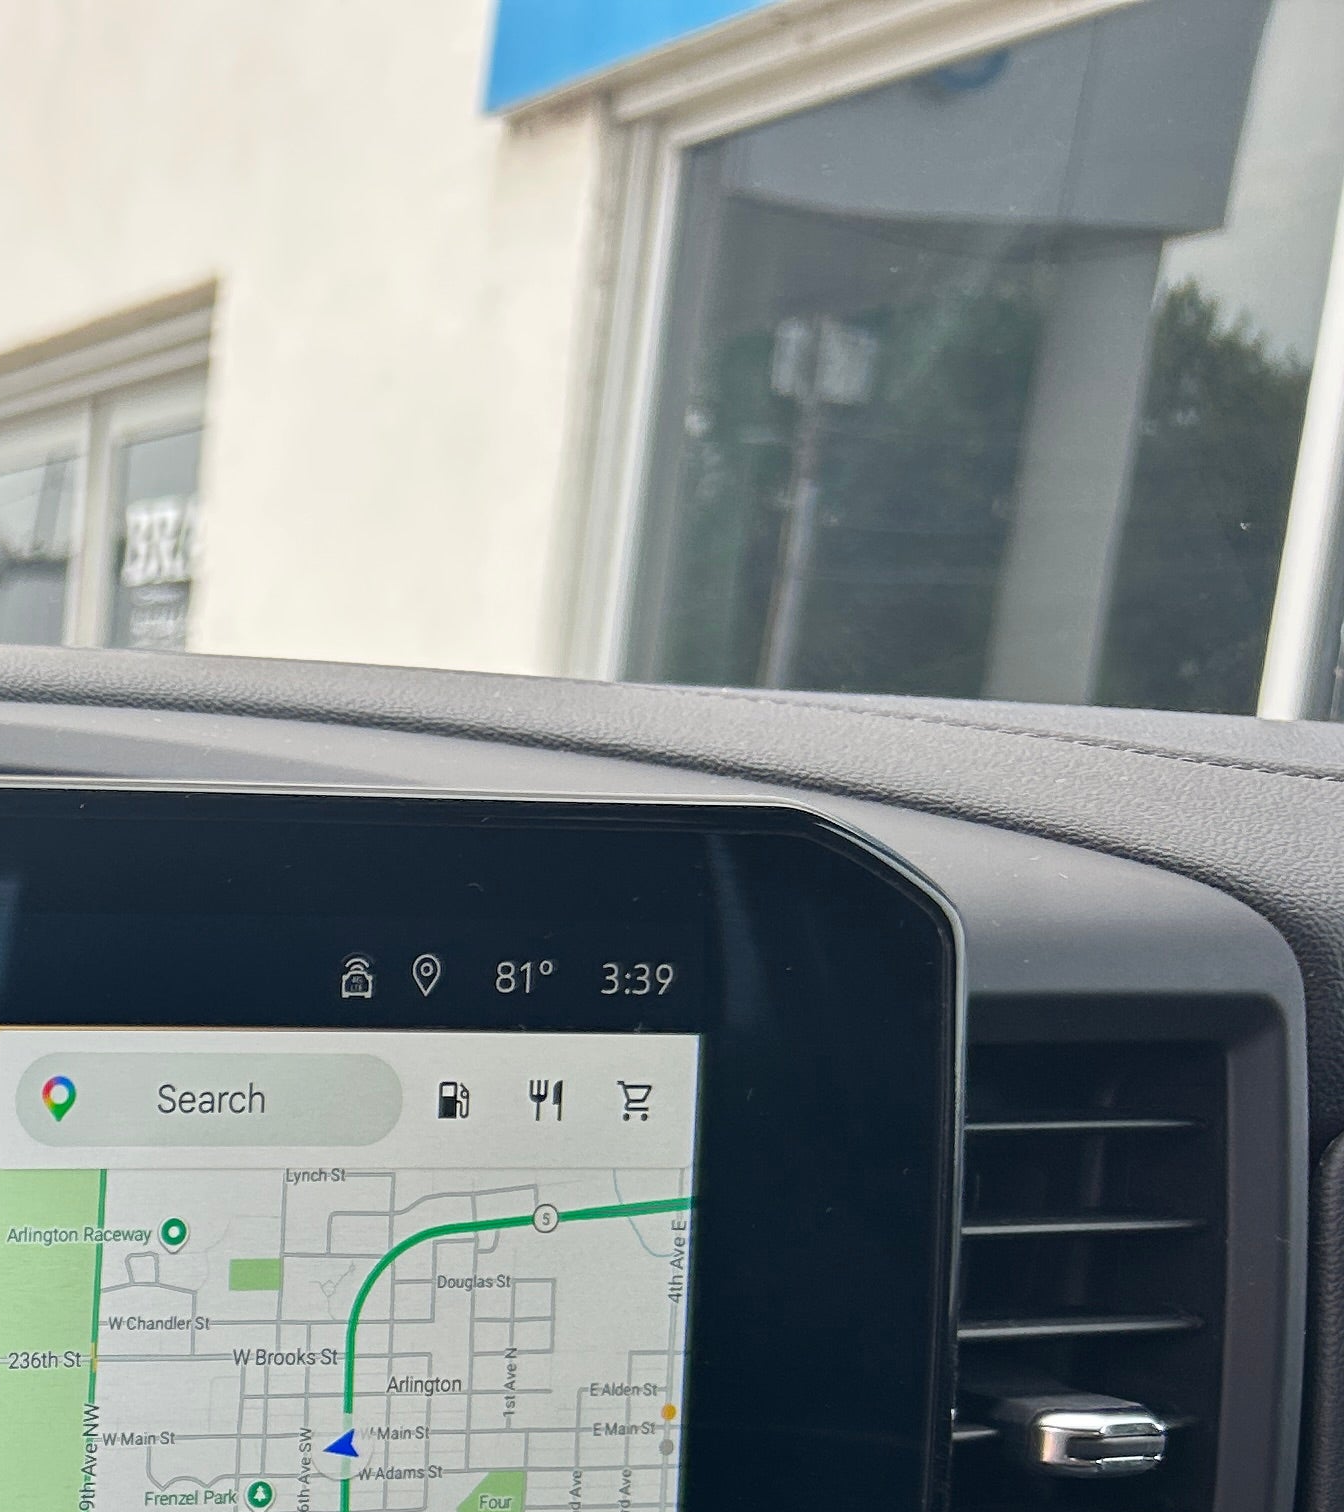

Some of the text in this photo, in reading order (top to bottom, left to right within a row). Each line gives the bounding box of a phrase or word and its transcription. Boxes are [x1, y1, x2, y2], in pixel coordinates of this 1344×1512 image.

[495, 960, 674, 996] 81° 3:39
[157, 1083, 266, 1114] Search
[285, 1168, 346, 1185] Lynch St
[541, 1212, 551, 1226] 5
[7, 1227, 152, 1246] Arlington Raceway
[668, 1219, 687, 1304] 4th Ave E
[437, 1274, 511, 1291] Douglas St
[108, 1316, 210, 1331] W Chandler St
[9, 1352, 82, 1369] 236th St
[233, 1348, 338, 1366] W Brooks St
[386, 1376, 462, 1396] Arlington
[503, 1347, 518, 1417] 1st Ave N
[590, 1383, 658, 1396] E Alden St
[377, 1427, 412, 1440] Main
[415, 1426, 430, 1439] St
[593, 1422, 656, 1436] E Main St
[102, 1431, 176, 1446] W Main St
[79, 1403, 100, 1512] 9th Ave NW
[297, 1427, 312, 1512] 6th Ave SW
[359, 1465, 443, 1480] W Adams St
[569, 1469, 583, 1498] Ave
[619, 1468, 633, 1496] Ave
[144, 1490, 237, 1506] Frenzel Park
[479, 1495, 512, 1509] Four
